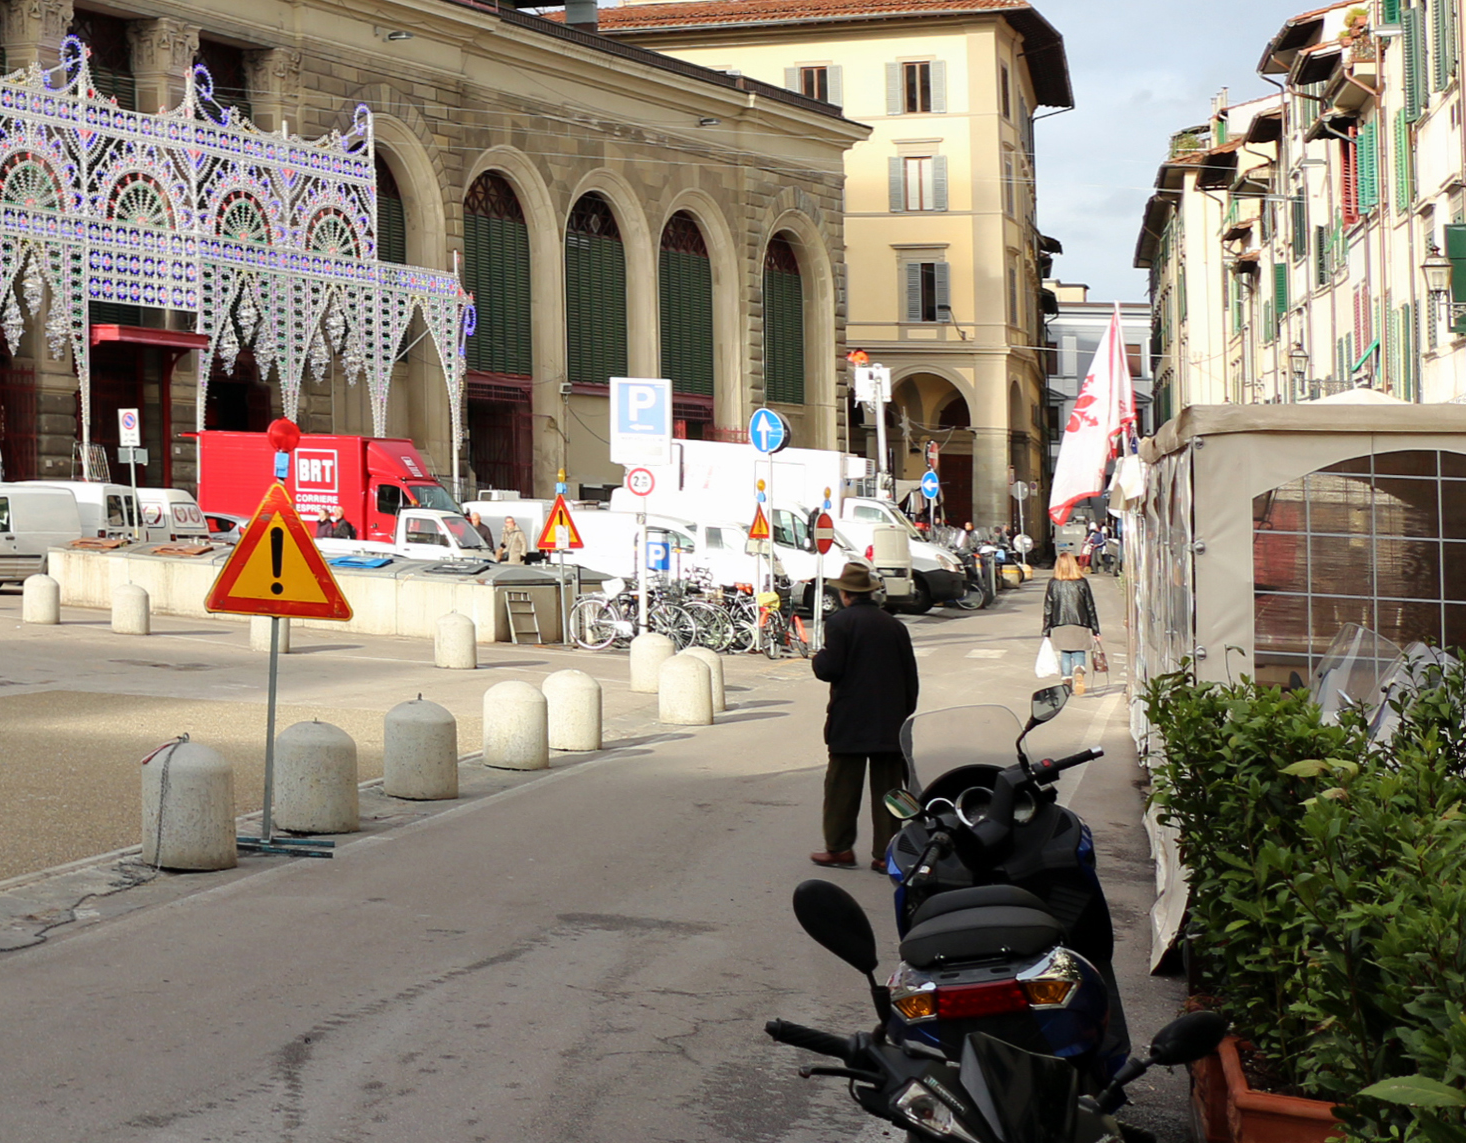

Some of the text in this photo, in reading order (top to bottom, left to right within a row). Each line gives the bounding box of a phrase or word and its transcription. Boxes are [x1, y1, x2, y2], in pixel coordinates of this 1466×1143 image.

[628, 385, 657, 422] P
[299, 458, 334, 483] BRT
[296, 494, 338, 504] CORRIERE
[649, 544, 666, 568] P
